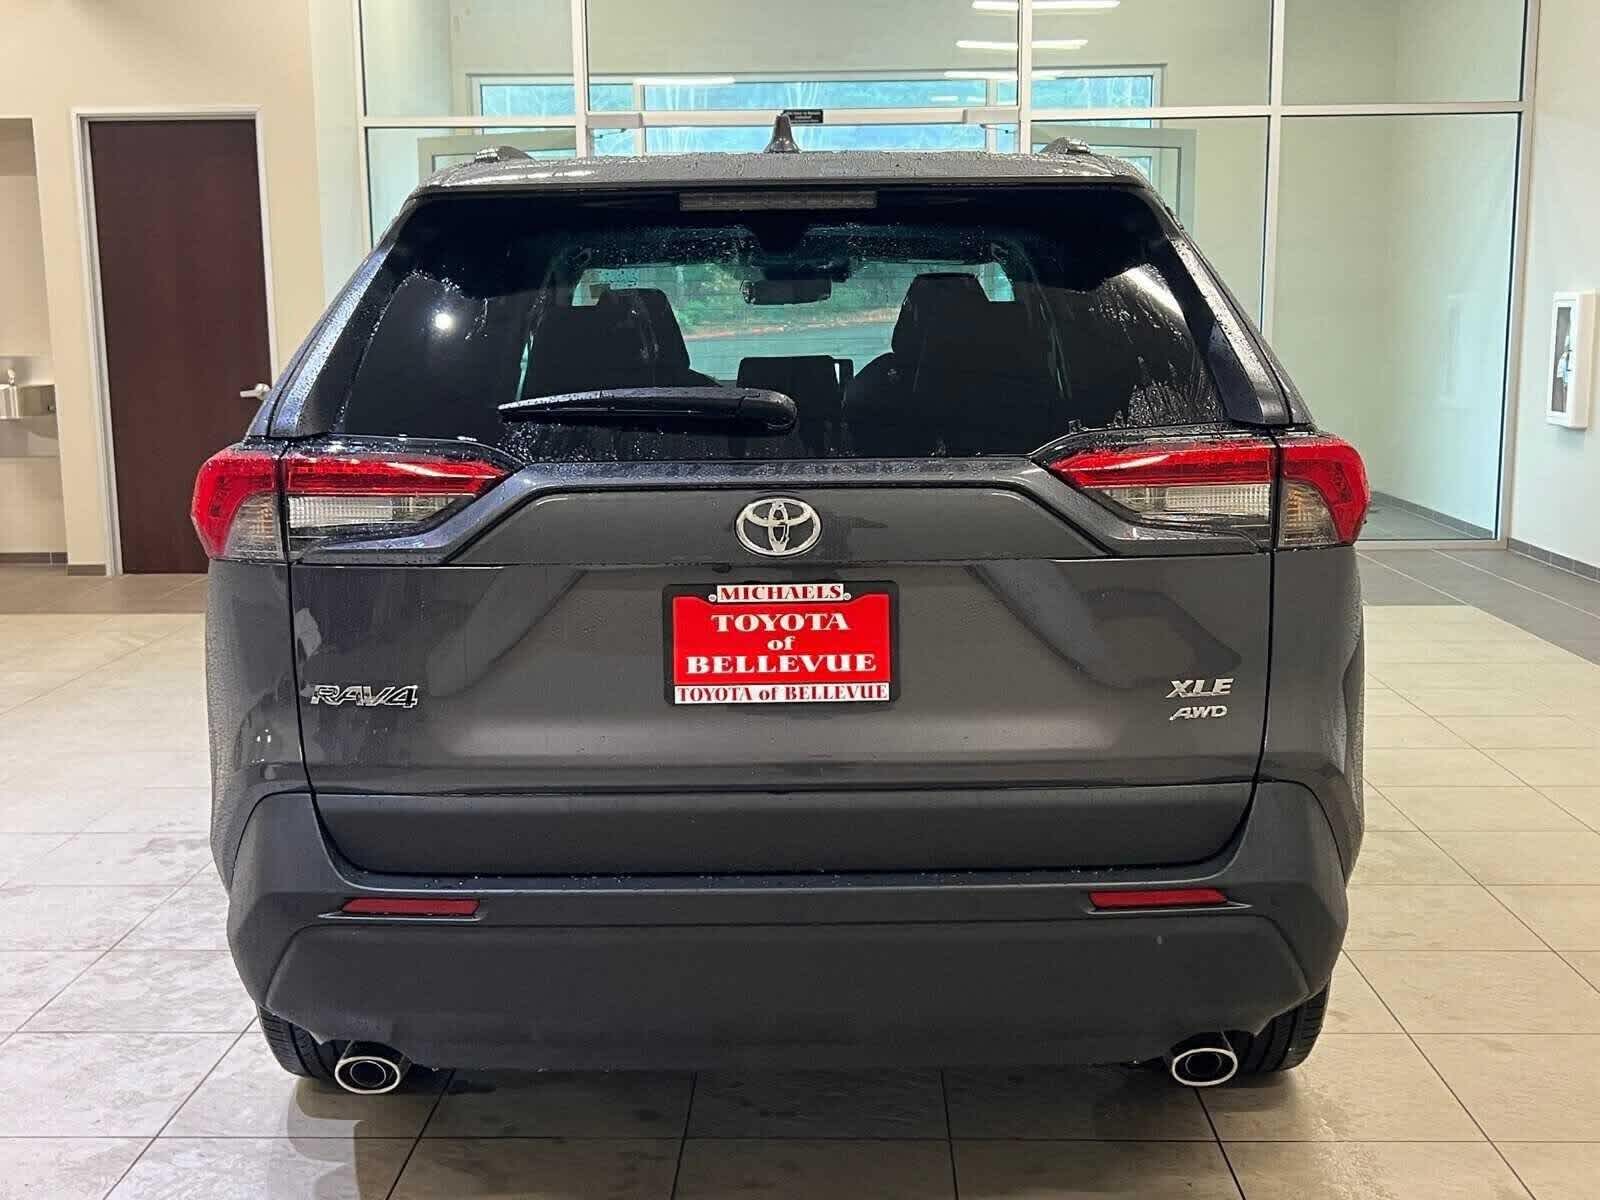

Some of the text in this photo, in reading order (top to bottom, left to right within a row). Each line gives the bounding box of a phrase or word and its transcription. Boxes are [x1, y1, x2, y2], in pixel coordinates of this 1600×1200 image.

[720, 585, 842, 601] MICHAELS
[711, 612, 849, 632] TOYOTA
[767, 636, 796, 651] of
[685, 653, 877, 674] BELLEVUE
[310, 684, 418, 708] RAV4
[677, 684, 888, 702] TOYOTA of BELLEVUE
[1165, 678, 1234, 698] XLE
[1169, 705, 1227, 720] AWD
